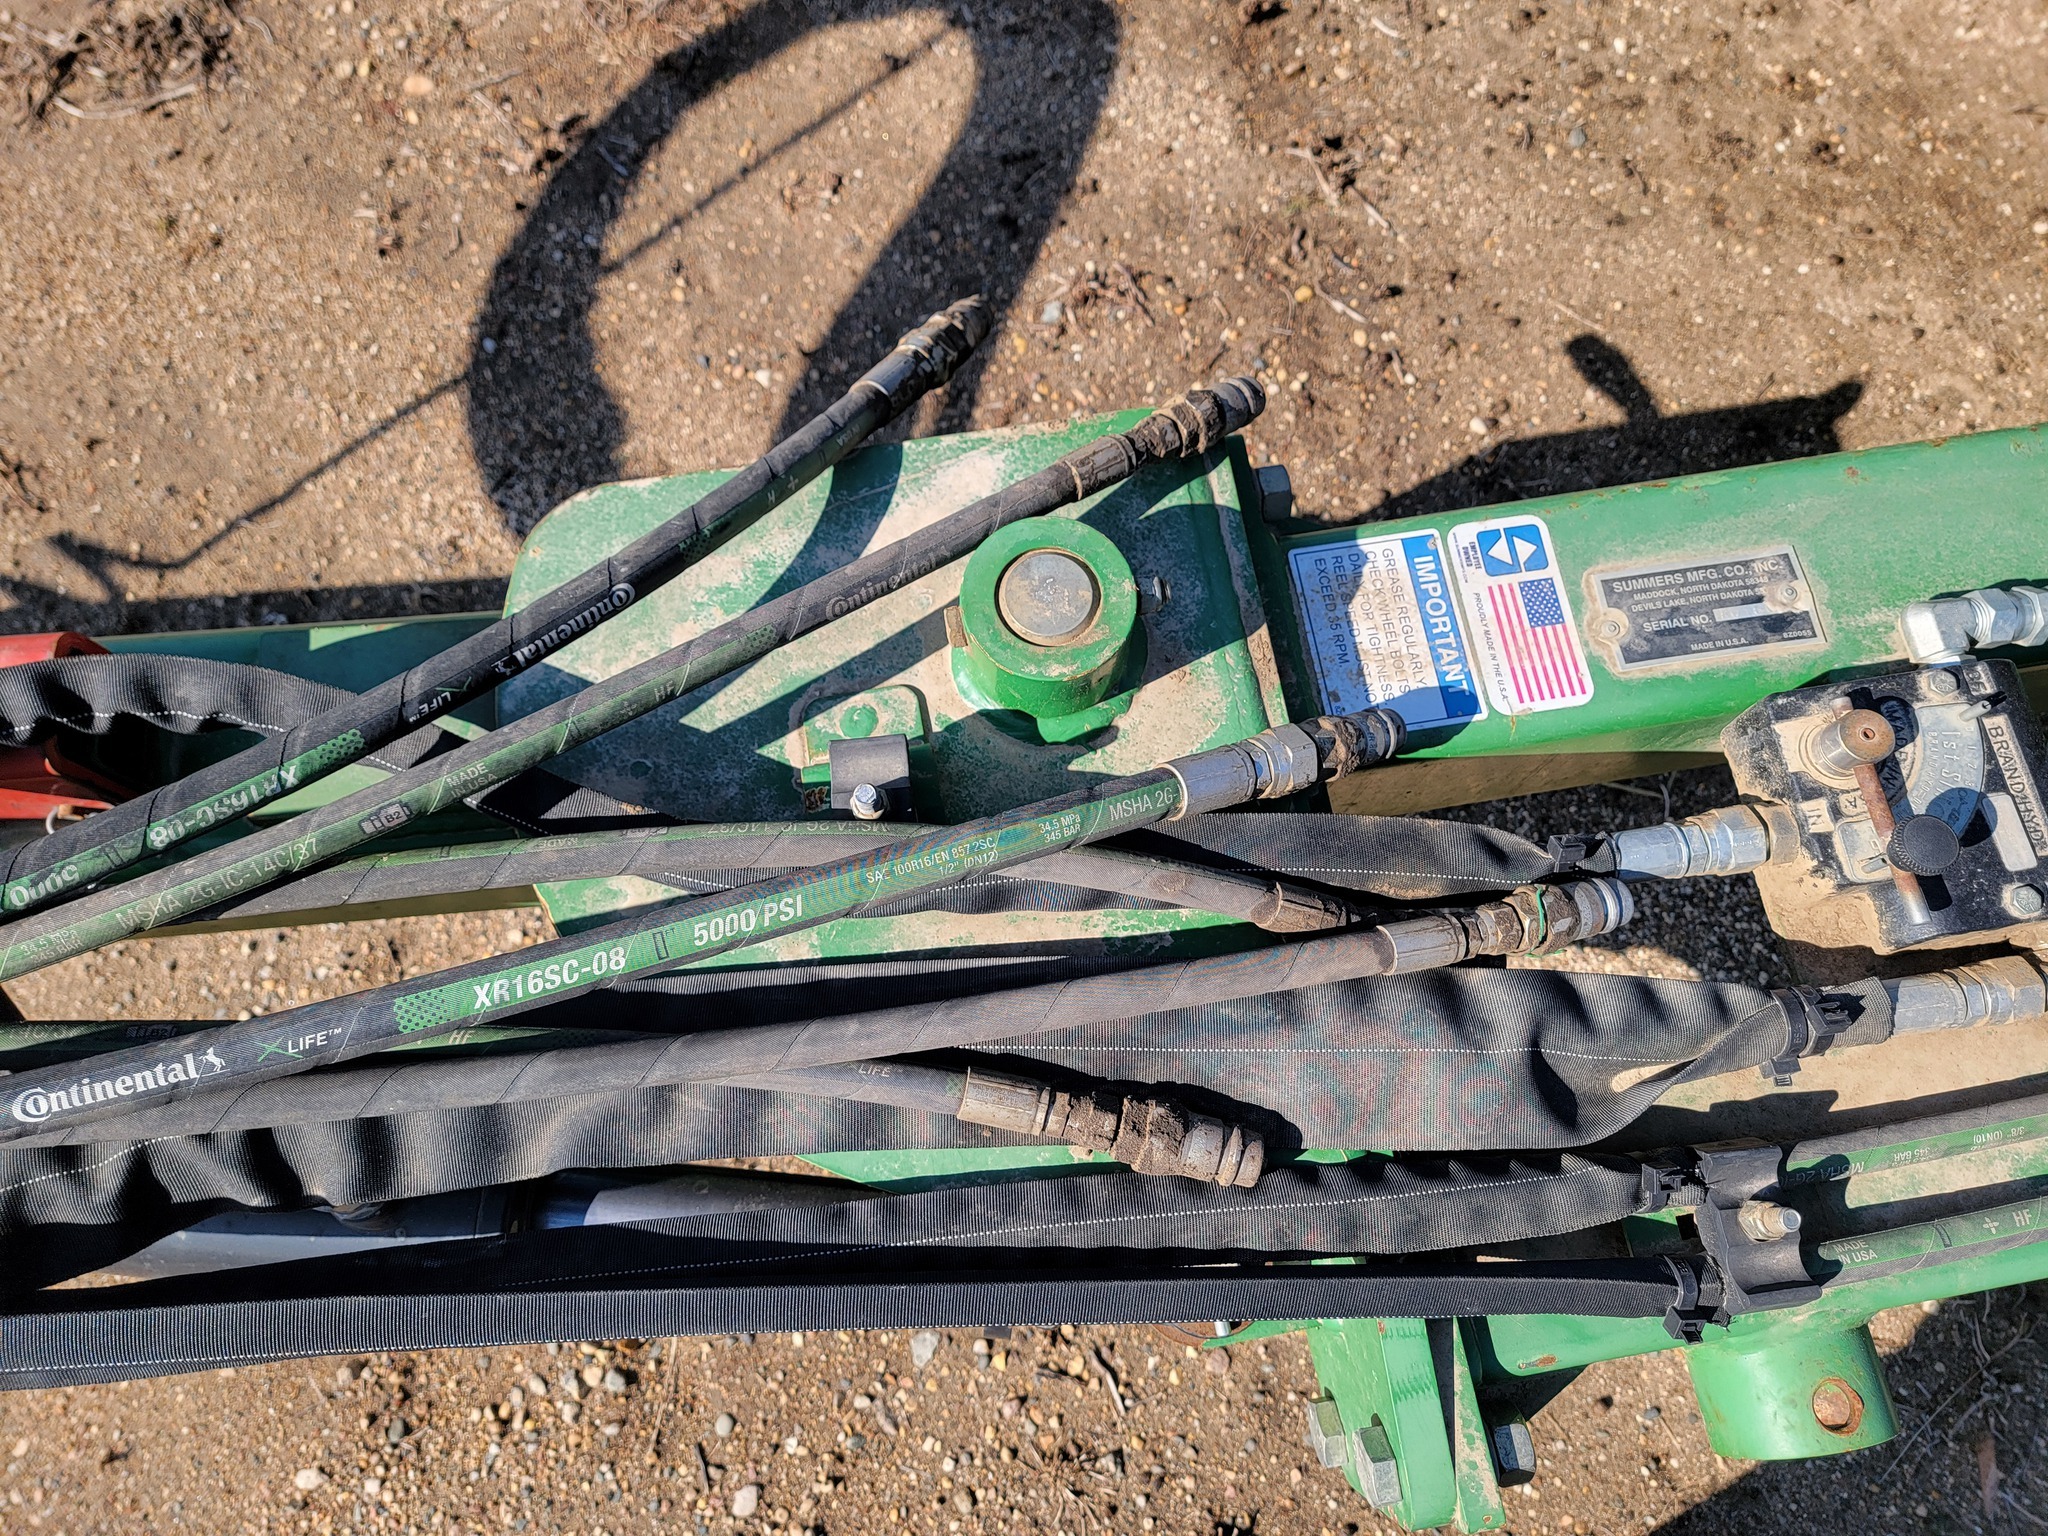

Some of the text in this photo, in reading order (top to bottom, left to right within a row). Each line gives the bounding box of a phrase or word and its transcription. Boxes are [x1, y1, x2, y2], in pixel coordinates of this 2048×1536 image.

[1461, 546, 1473, 566] OWNED
[1468, 541, 1482, 569] EMPLOYEE
[1330, 555, 1348, 589] REEL
[1610, 572, 1684, 593] SUMMERS
[1685, 567, 1721, 582] MFG.
[1752, 558, 1783, 572] INC.
[1630, 601, 1662, 612] DEVILS
[1662, 597, 1689, 608] LAKE,
[1688, 593, 1719, 604] NORTH
[1719, 588, 1753, 599] DAKOTA
[1632, 588, 1679, 601] MADDOCK,
[1679, 583, 1710, 594] NORTH
[1709, 578, 1744, 590] DAKOTA
[513, 584, 636, 664] Continental
[1313, 558, 1350, 667] EXCEED 35 RPM.
[1338, 592, 1361, 637] SPEED
[1363, 550, 1411, 694] CHECK WHEEL BOLTS
[1380, 548, 1428, 688] GREASE REGULARLY.
[1472, 592, 1489, 629] PROUDLY
[1641, 613, 1712, 632] SERIAL NO.
[1347, 553, 1367, 590] DAILY
[1357, 593, 1373, 620] FOR
[1365, 626, 1395, 705] TIGHTNESS.
[1413, 556, 1469, 695] IMPORTANT
[1483, 628, 1495, 652] MADE
[1690, 641, 1713, 650] MADE
[1351, 640, 1371, 678] MUST
[1489, 652, 1498, 661] IN
[1492, 662, 1502, 677] THE
[1988, 725, 2025, 794] BRAND
[445, 761, 489, 788] MADE
[450, 771, 497, 798] IN USA
[1107, 795, 1153, 822] MSHA
[1806, 807, 1825, 826] IN
[1037, 813, 1082, 834] 34.5 MPa
[1042, 823, 1082, 843] 345 BAR
[865, 867, 891, 884] SAE
[891, 849, 953, 877] 100R16/EN
[951, 844, 970, 859] 857
[962, 848, 1000, 870] (DN12)
[116, 892, 183, 930] MSHA
[689, 892, 806, 947] 5000 PSI
[473, 945, 627, 1008] XR16SC-08
[11, 1052, 199, 1122] Continental
[1972, 1129, 2003, 1144] (DN10)
[1892, 1149, 1912, 1161] BAR
[1913, 1145, 1931, 1157] 345
[2012, 1208, 2033, 1227] HF
[1834, 1237, 1868, 1254] MADE
[1852, 1247, 1877, 1263] USA
